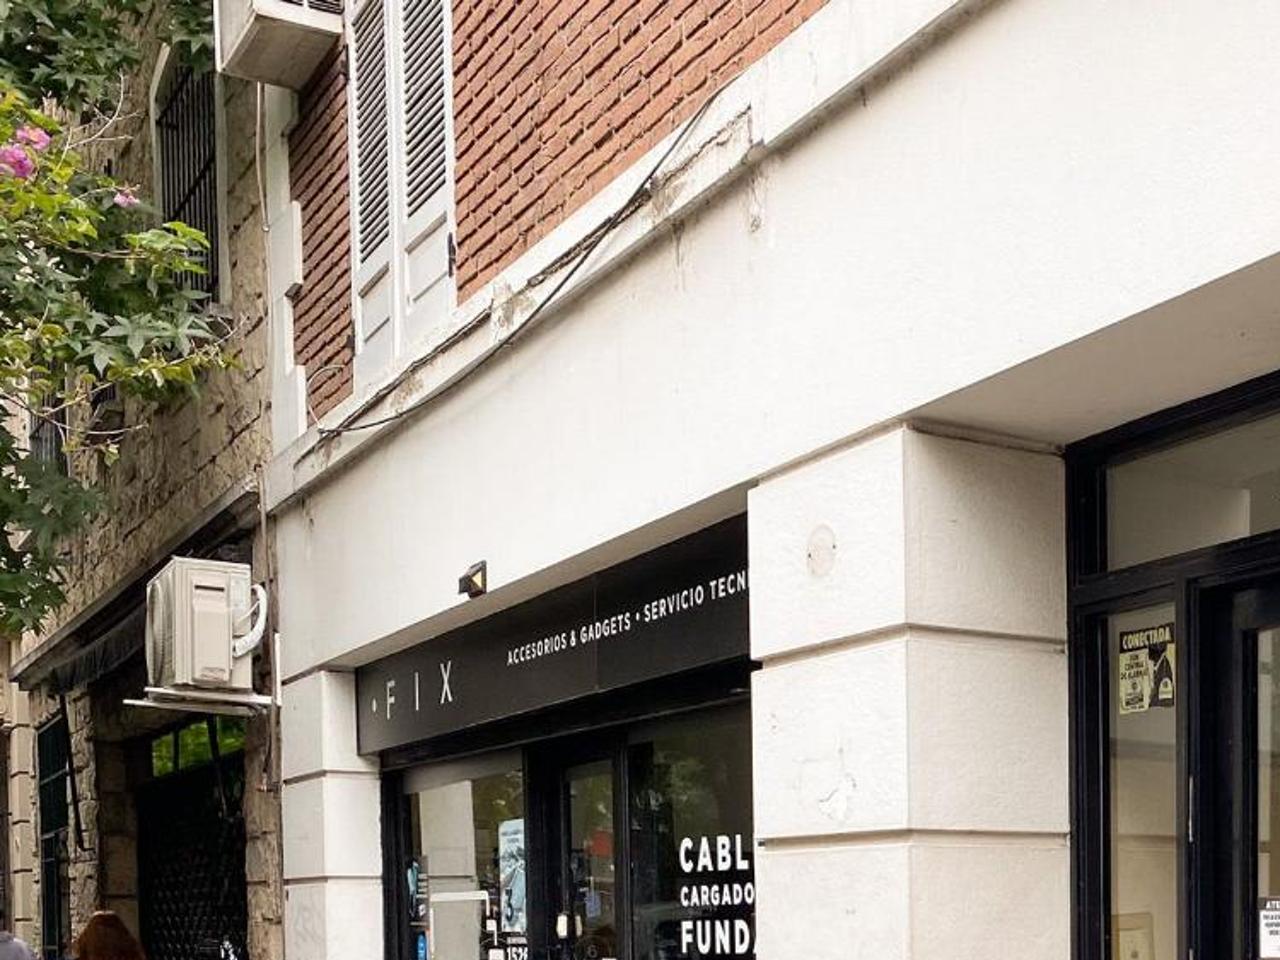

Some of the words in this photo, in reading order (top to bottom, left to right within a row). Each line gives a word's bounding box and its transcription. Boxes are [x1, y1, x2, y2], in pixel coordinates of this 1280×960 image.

[507, 632, 567, 666] ACCESORIOS
[569, 629, 577, 647] &
[580, 612, 631, 644] GADGETS
[644, 585, 704, 622] SERVICIO
[709, 570, 748, 600] TECN
[1122, 626, 1171, 650] CONECTADA
[679, 834, 749, 873] CABL
[680, 882, 755, 907] CARGADO
[681, 919, 757, 955] FUND
